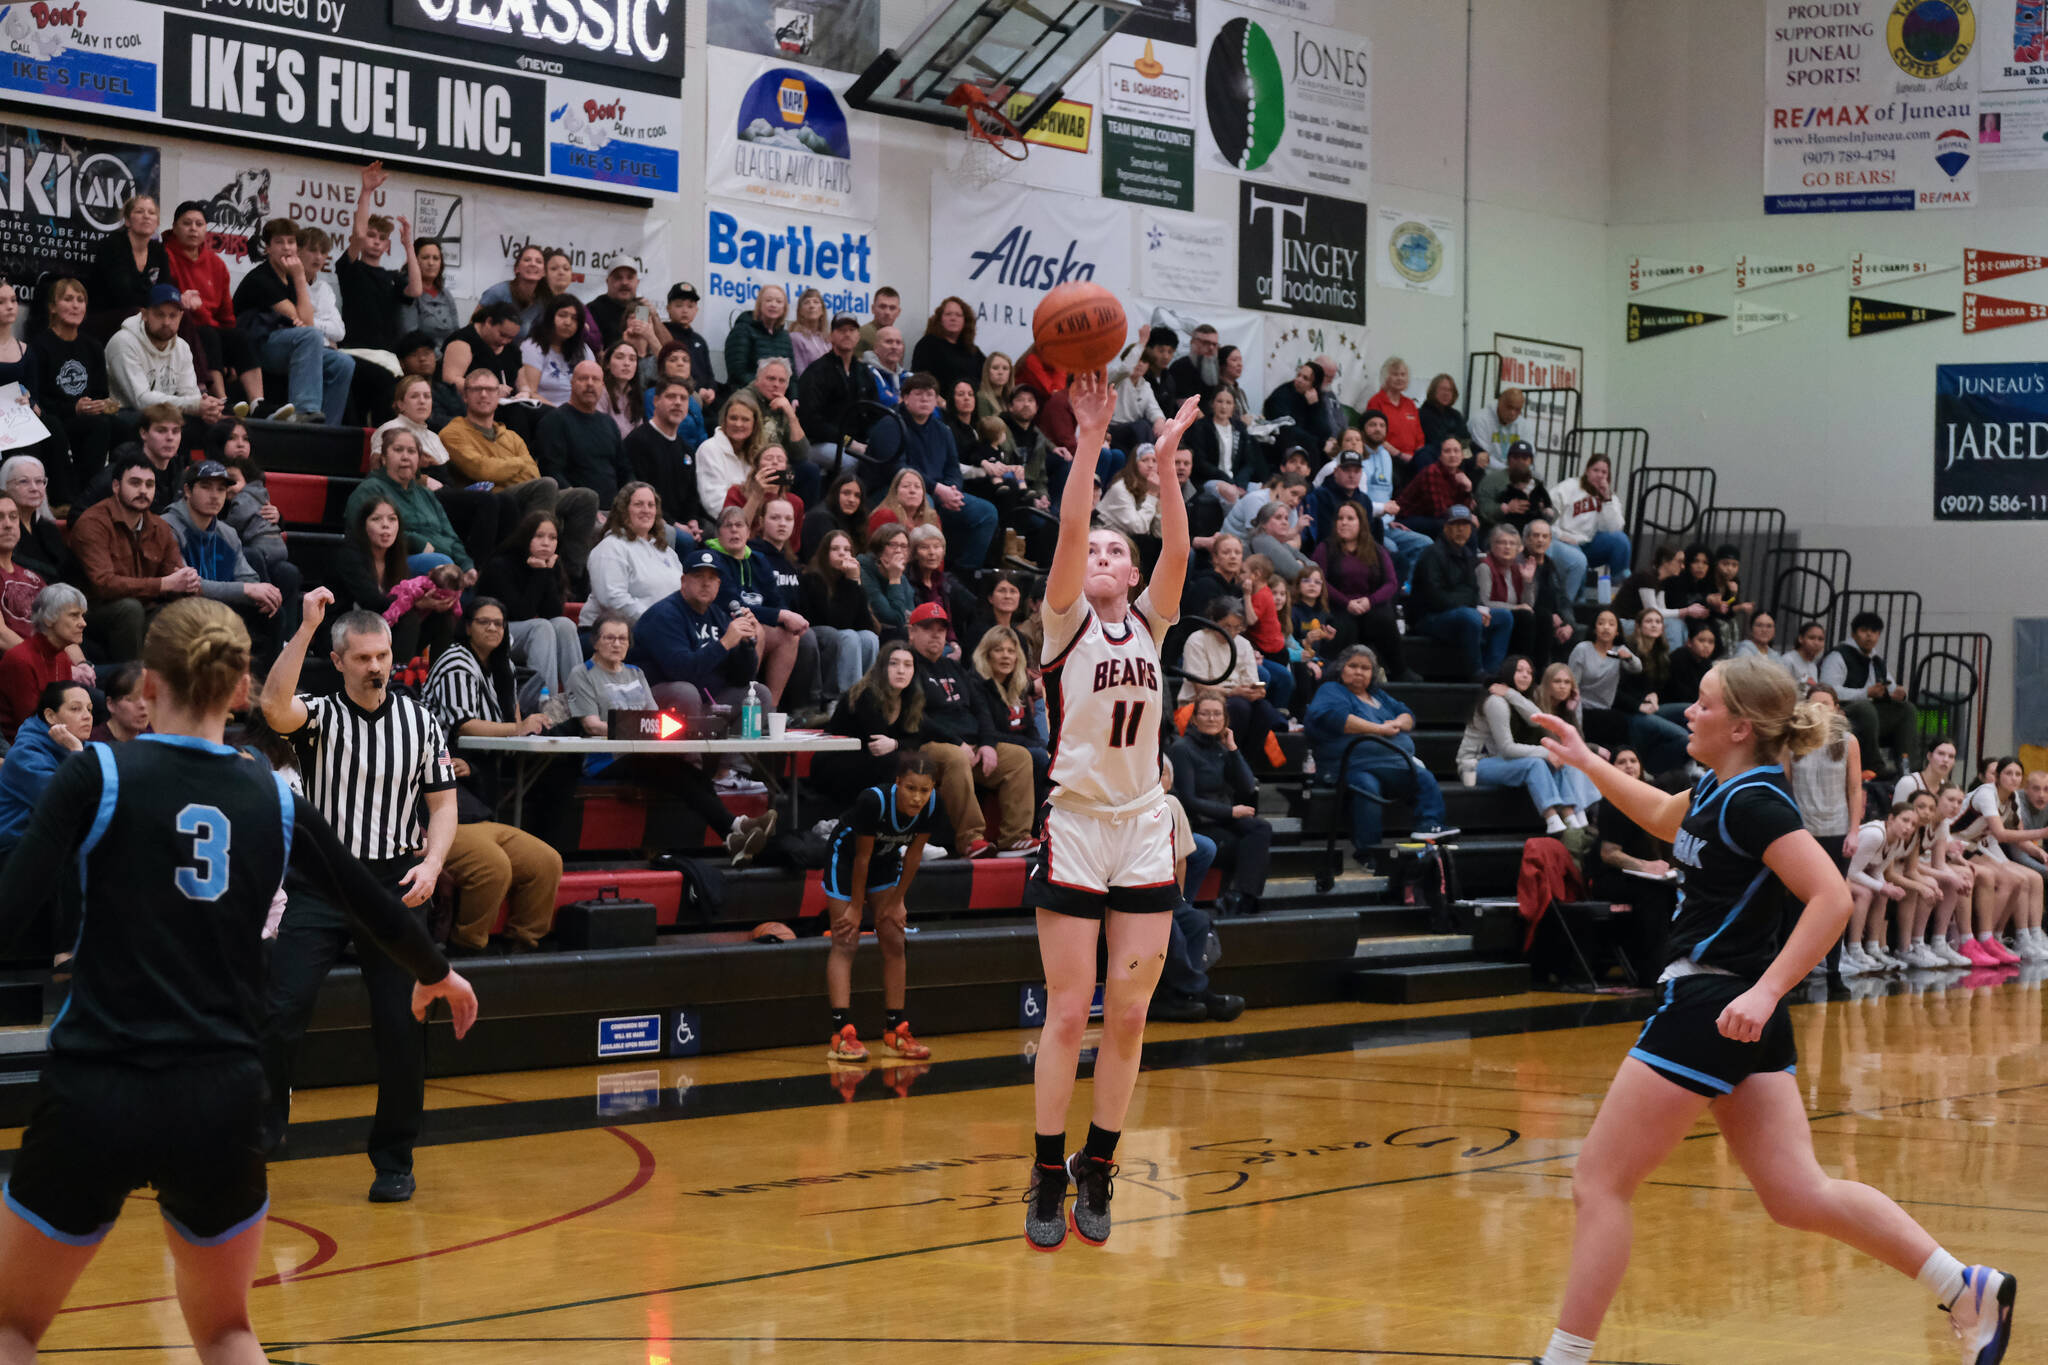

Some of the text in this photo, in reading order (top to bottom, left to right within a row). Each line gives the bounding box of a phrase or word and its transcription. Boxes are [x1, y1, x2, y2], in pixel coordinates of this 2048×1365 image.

[316, 0, 346, 33] by
[1788, 2, 1862, 20] PROUDLY
[71, 28, 141, 48] PLAY IT COOL
[1775, 23, 1874, 42] SUPPORTING
[11, 40, 30, 54] CALL
[1787, 44, 1860, 66] JUNEAU
[1291, 30, 1368, 88] JONES
[1786, 67, 1860, 87] SPORTS!
[2003, 67, 2026, 77] Haa
[80, 72, 133, 95] FUEL
[190, 33, 521, 157] IKE'S FUEL, INC.
[782, 91, 804, 113] NAPA
[1773, 101, 1971, 129] RE/MAX of Juneau
[614, 121, 667, 138] PLAY IT COOL
[1107, 120, 1131, 136] TEAM
[621, 160, 661, 178] FUEL
[735, 144, 852, 193] GLACIER AUTO PARTS
[1802, 150, 1834, 166] (907)
[0, 147, 71, 218] KI
[1802, 169, 1896, 187] GO BEARS!
[296, 180, 386, 208] JUNEU
[1919, 191, 1971, 203] RE/MAX
[18, 233, 34, 243] TO
[39, 236, 87, 250] CREATE
[37, 224, 53, 235] TO
[58, 227, 74, 238] BE
[80, 229, 110, 241] HAP
[33, 246, 58, 258] FOR
[64, 252, 97, 264] OTHE
[569, 243, 585, 266] in
[709, 210, 871, 284] Bartlett
[1249, 186, 1360, 308] TINGEY
[2026, 257, 2042, 269] 52
[710, 272, 791, 304] Regiol
[976, 302, 1027, 327] AIRL
[2030, 306, 2047, 318] 52
[1501, 356, 1576, 389] Win For Life!
[1958, 372, 2045, 398] JUNEAU'S
[1944, 422, 2048, 471] JARED
[1940, 495, 1984, 514] (907)
[1093, 657, 1158, 693] BEARS
[1109, 700, 1146, 749] 11
[175, 803, 232, 902] 3
